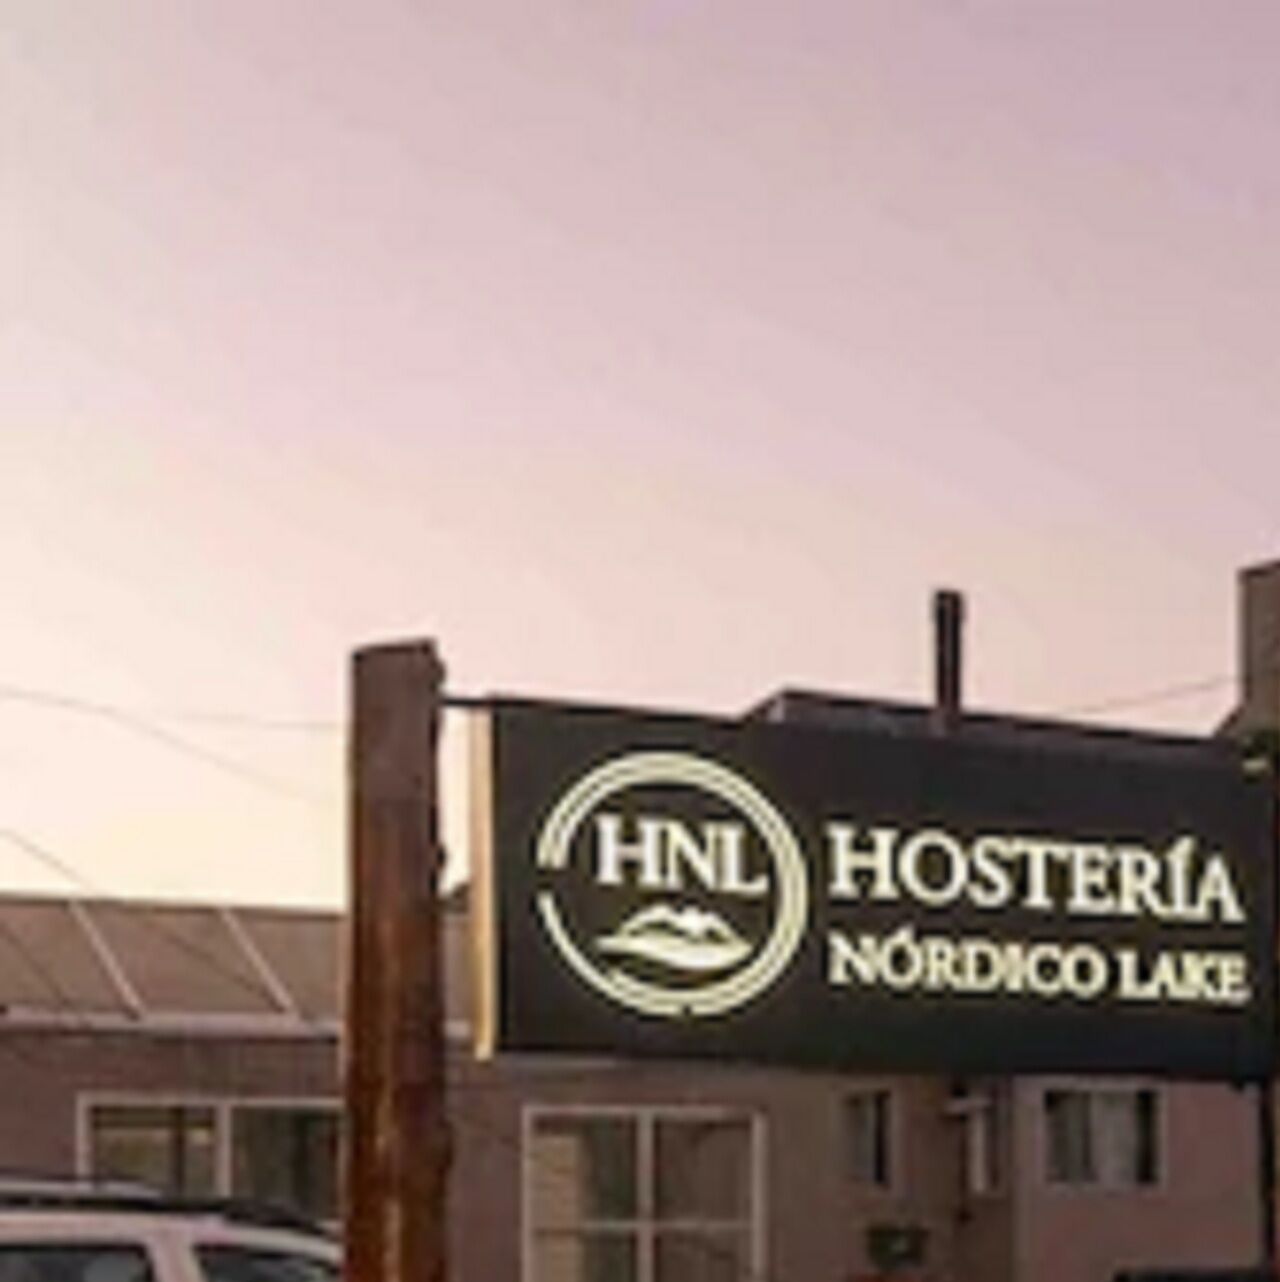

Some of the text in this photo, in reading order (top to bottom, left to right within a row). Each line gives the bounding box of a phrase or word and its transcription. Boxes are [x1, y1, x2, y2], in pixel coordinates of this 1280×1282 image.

[599, 814, 768, 894] HNL
[827, 824, 1245, 923] HOSTERÍA
[828, 930, 1248, 1003] NÓRDICO LAKE
